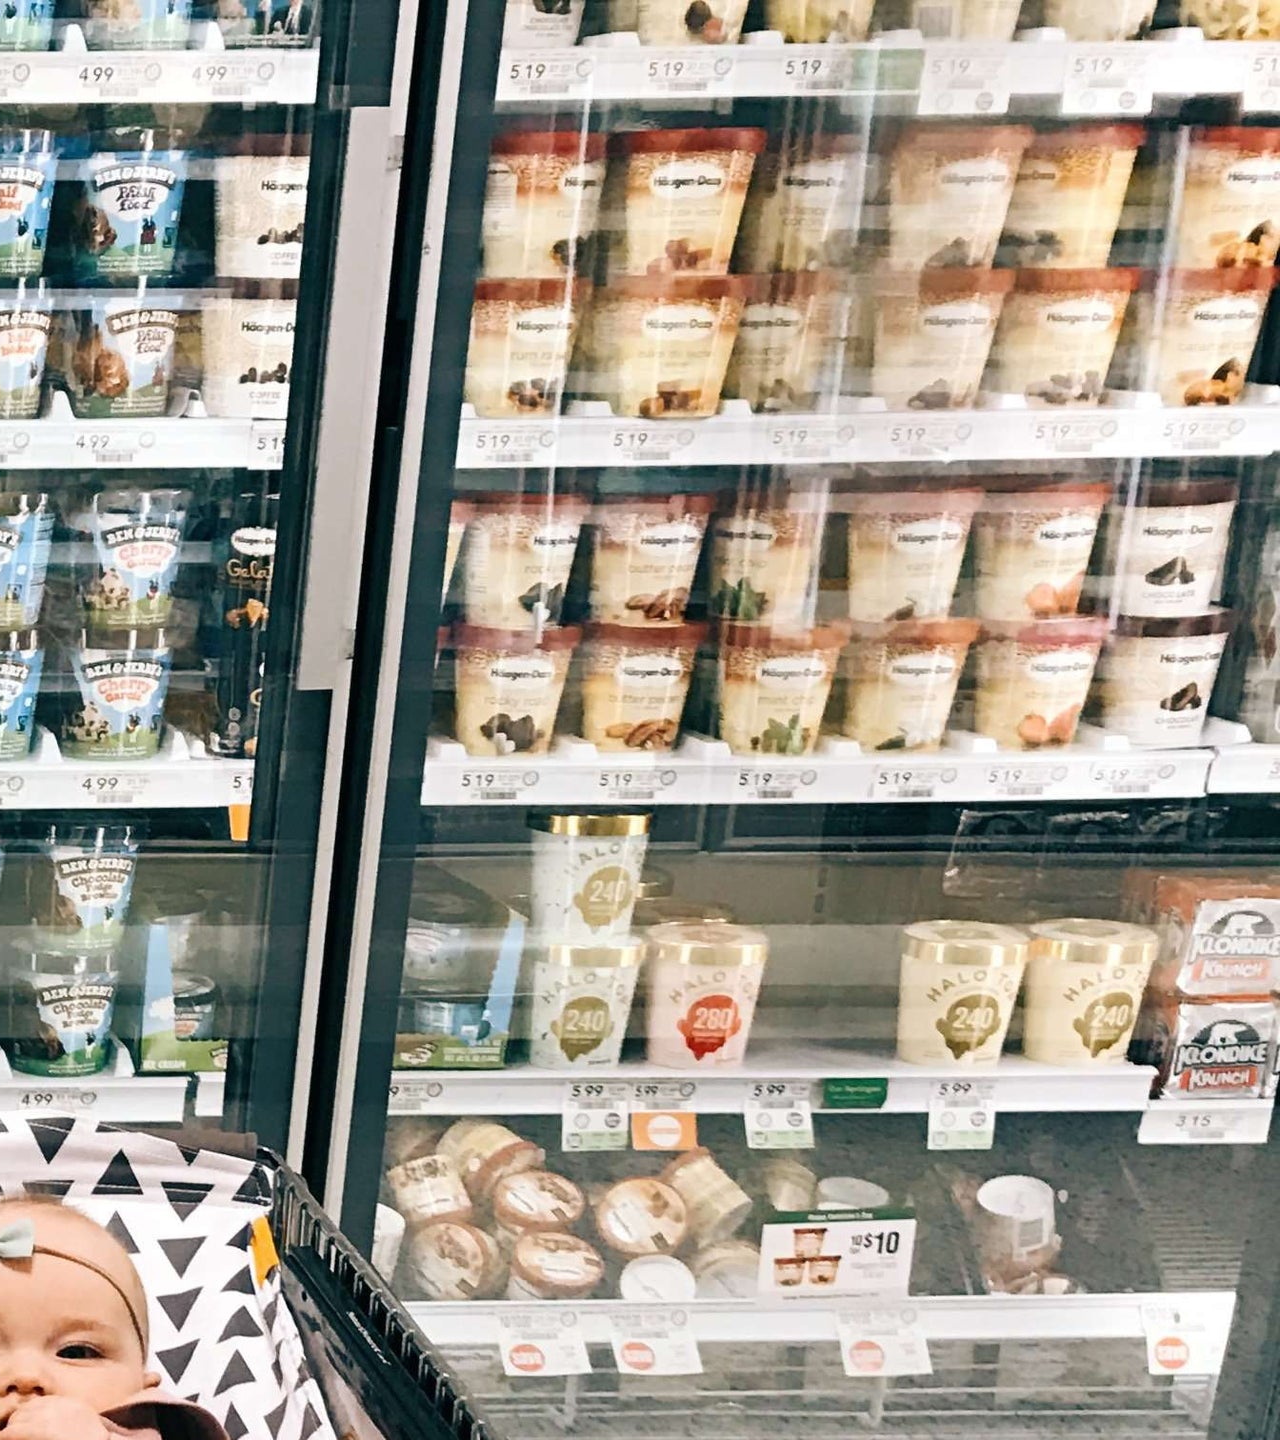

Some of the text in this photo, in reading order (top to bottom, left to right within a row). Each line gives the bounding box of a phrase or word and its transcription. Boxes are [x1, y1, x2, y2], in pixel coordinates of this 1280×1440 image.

[927, 968, 988, 1003] HALO
[565, 1011, 605, 1032] 240
[693, 1007, 734, 1030] 280
[954, 1006, 993, 1030] 240
[1092, 1004, 1129, 1028] 240
[1175, 1043, 1268, 1074] KLONDIKE
[864, 1231, 899, 1254] $10
